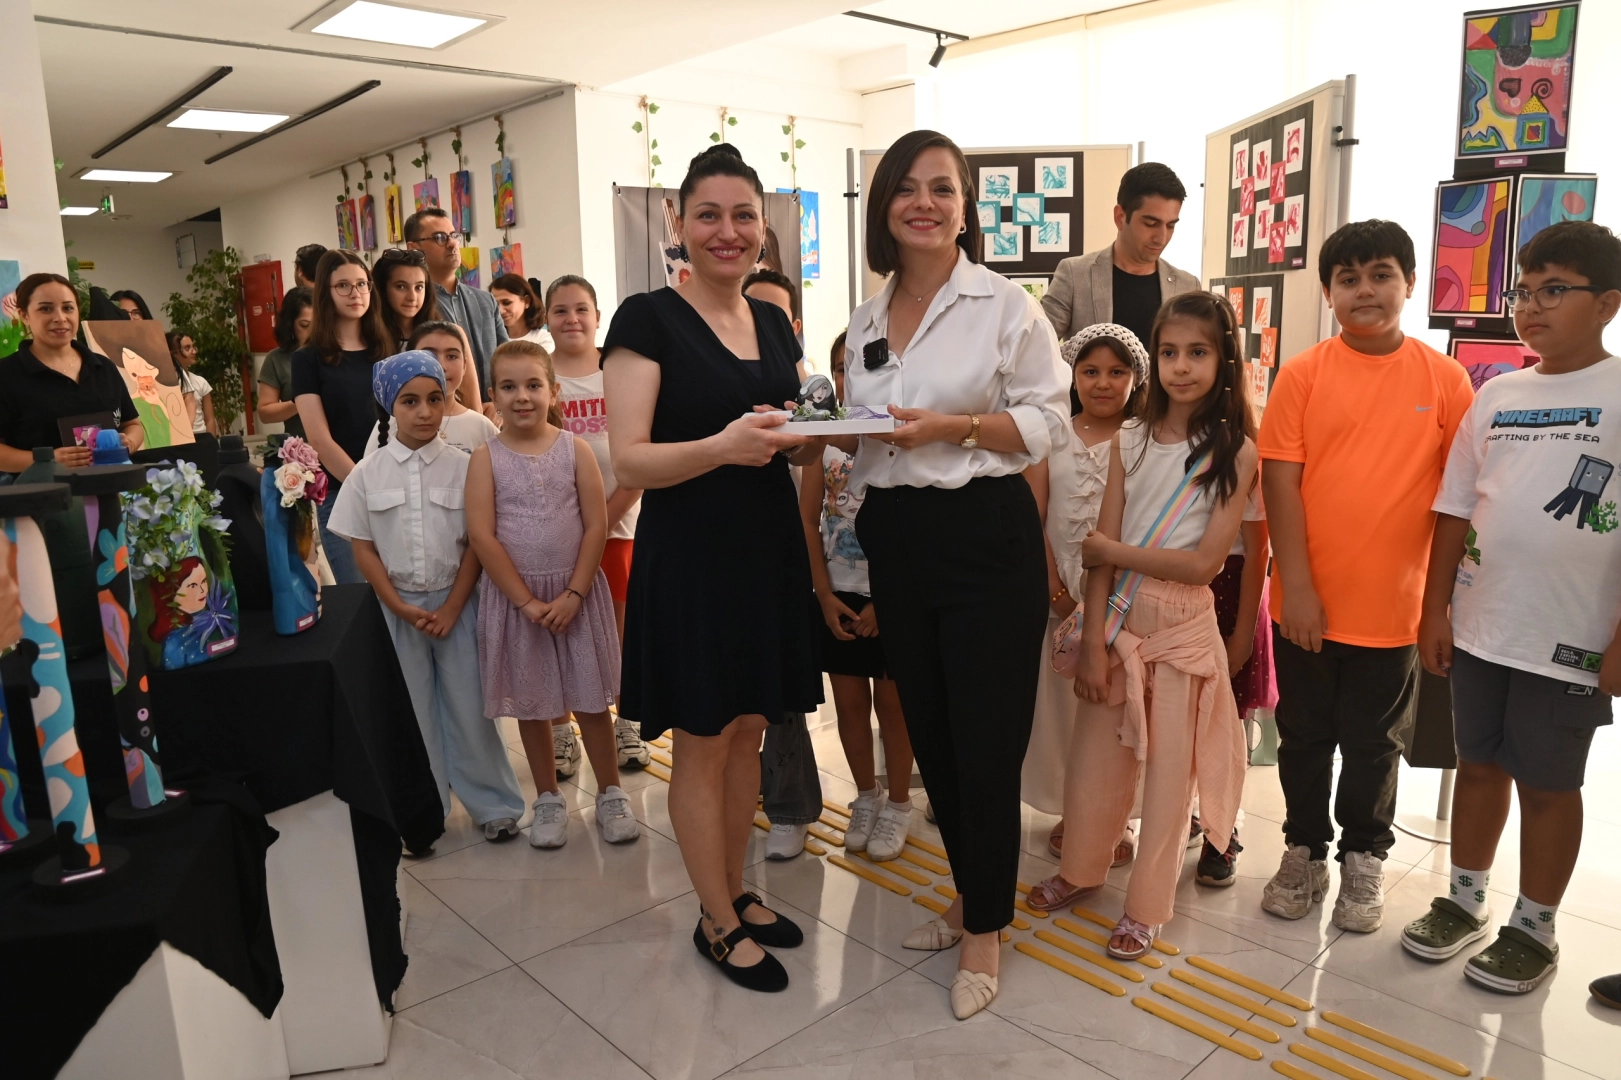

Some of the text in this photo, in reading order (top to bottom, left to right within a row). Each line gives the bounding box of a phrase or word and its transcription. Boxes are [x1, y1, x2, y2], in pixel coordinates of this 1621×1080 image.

[1490, 407, 1602, 429] MINECRAFT
[1485, 434, 1530, 443] CRAFTING
[1574, 433, 1600, 444] SEA
